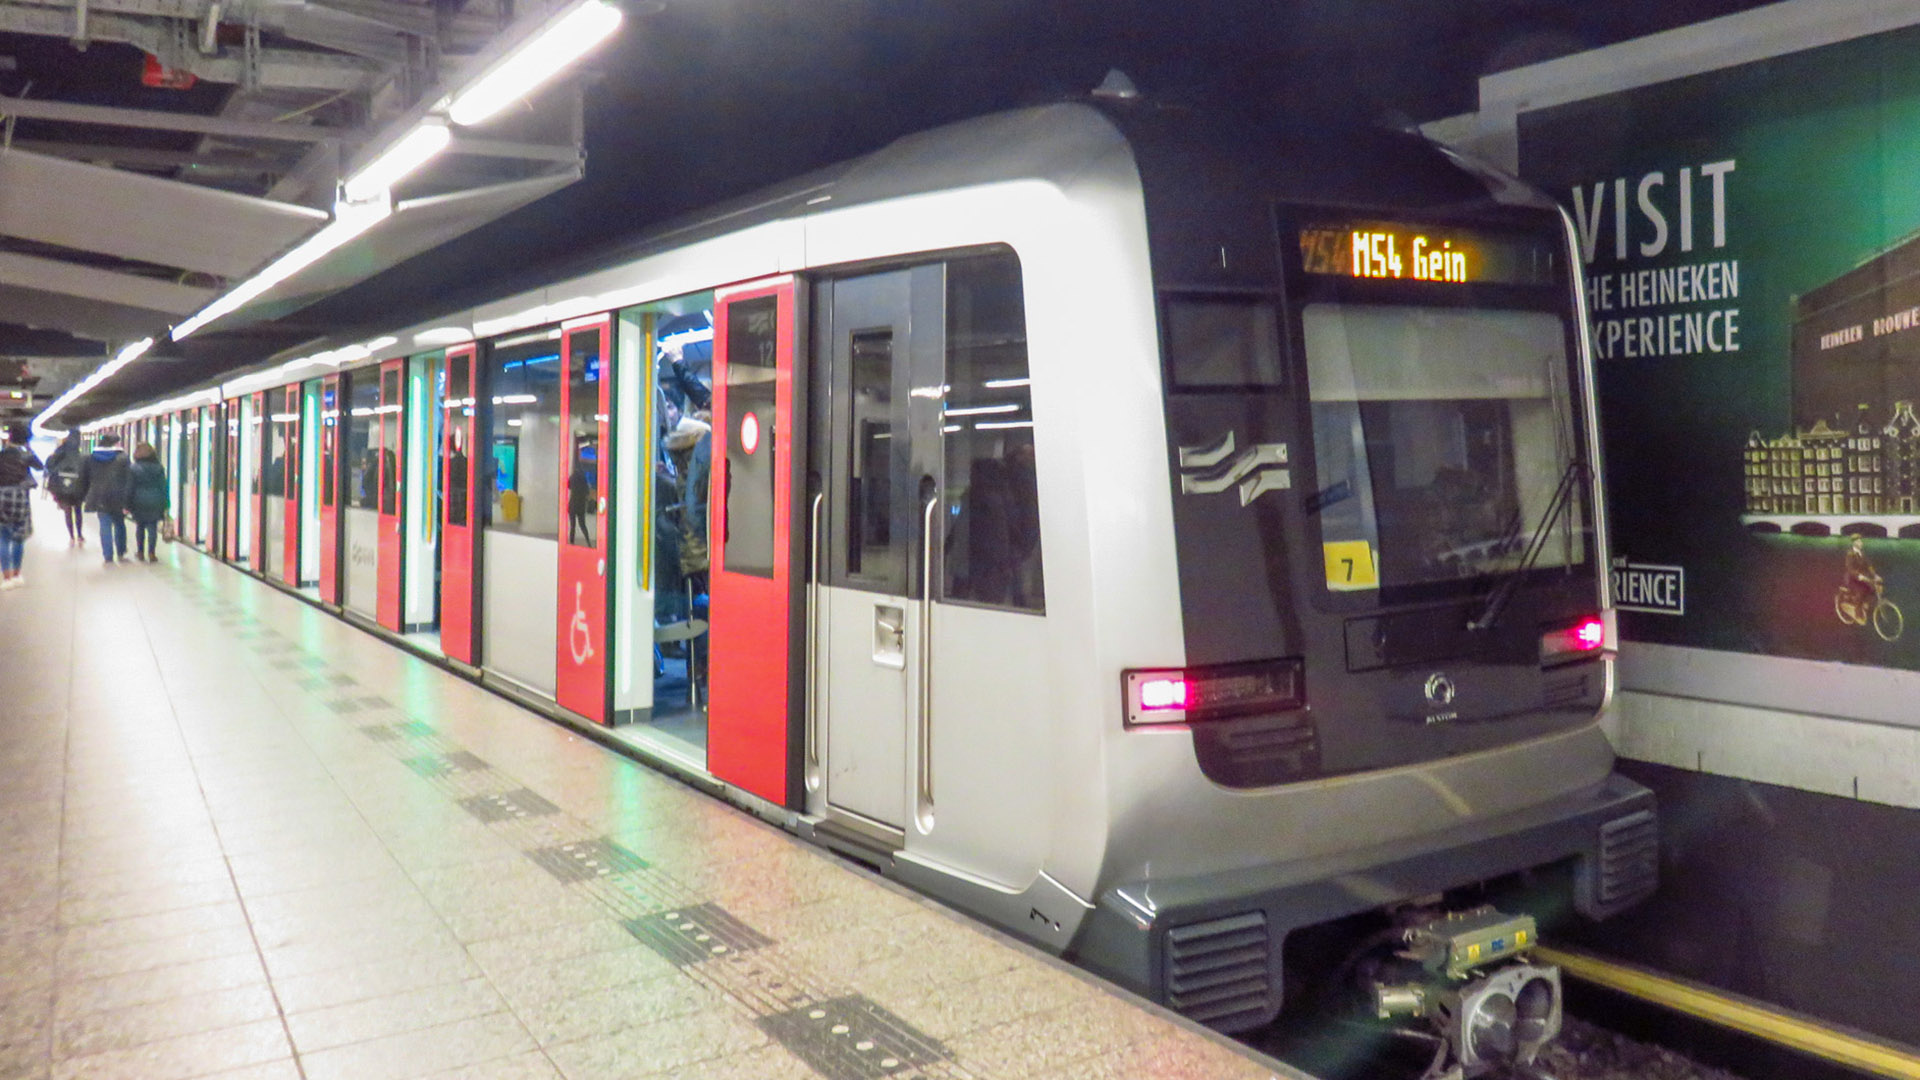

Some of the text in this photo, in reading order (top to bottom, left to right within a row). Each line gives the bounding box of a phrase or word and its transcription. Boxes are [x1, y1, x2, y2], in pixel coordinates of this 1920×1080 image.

[1572, 160, 1736, 264] VISIT
[1352, 231, 1402, 278] M54
[1412, 236, 1466, 283] Gein
[1584, 260, 1739, 311] HE HEINEKEN
[1591, 310, 1740, 360] XPERIENCE
[1341, 558, 1354, 582] 7
[1613, 570, 1678, 606] RIENCE
